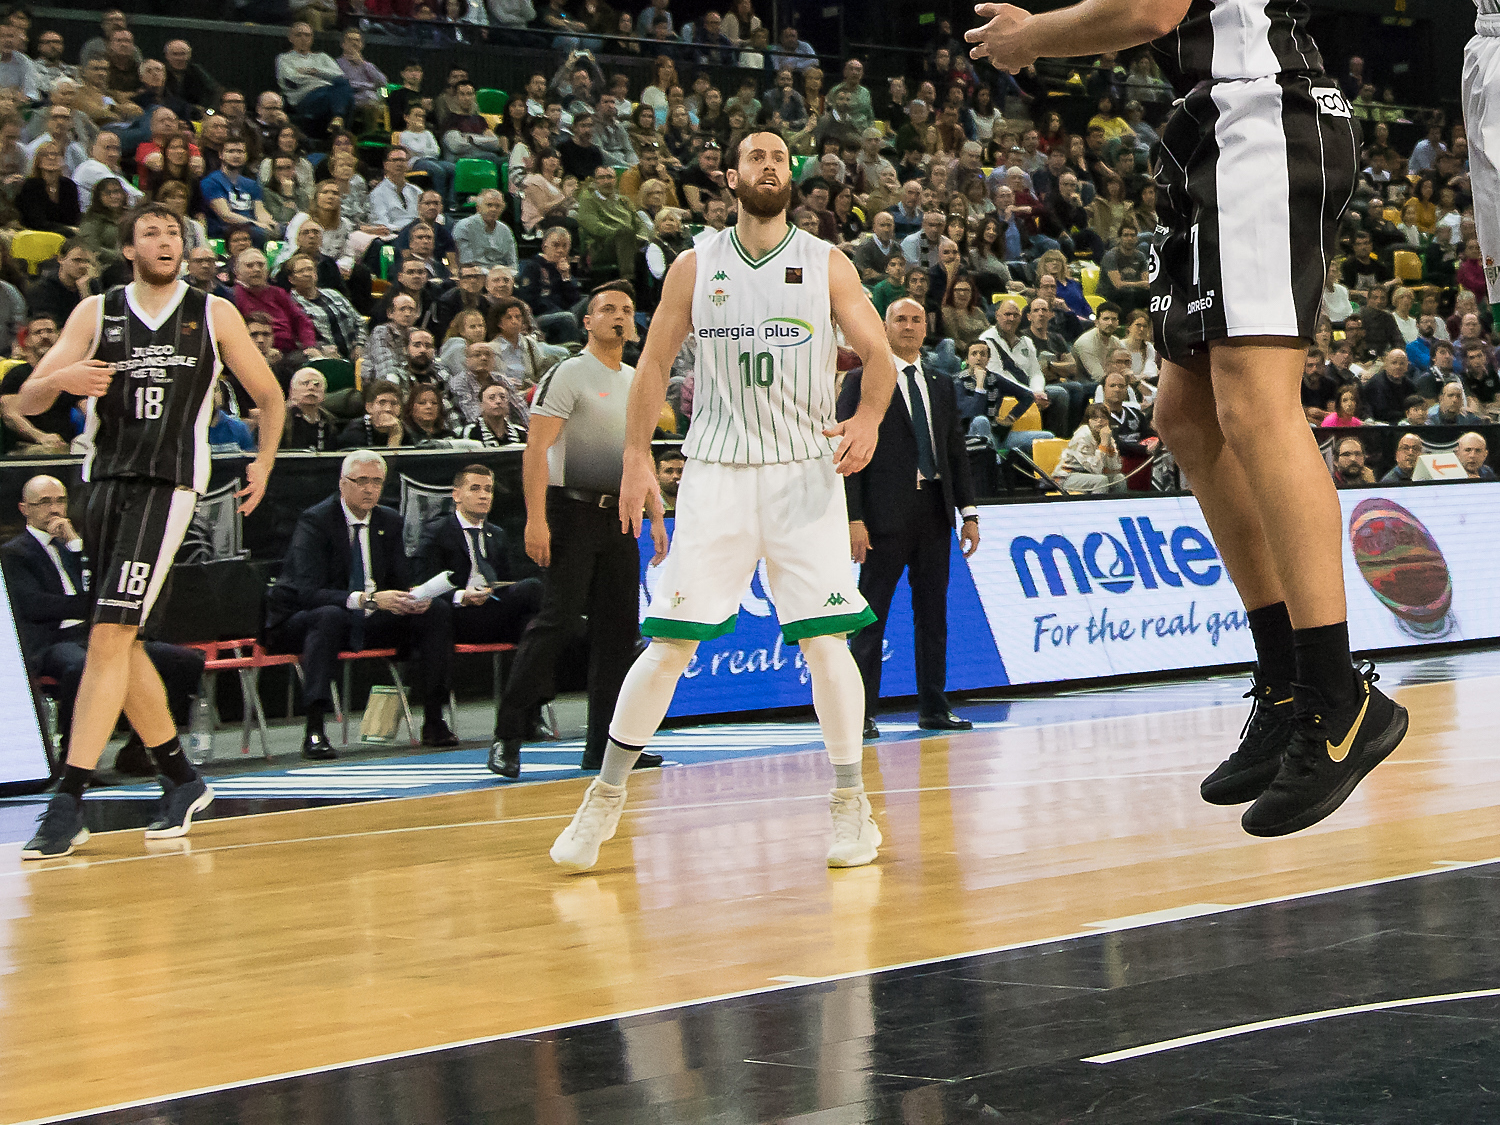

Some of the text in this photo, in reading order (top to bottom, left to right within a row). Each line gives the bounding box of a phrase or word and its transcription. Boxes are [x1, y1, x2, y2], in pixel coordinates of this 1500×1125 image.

[699, 324, 800, 341] energía plus
[738, 351, 775, 389] 10
[134, 386, 165, 420] 18
[1010, 516, 1223, 598] molte
[117, 560, 151, 595] 18
[1034, 601, 1251, 654] For the real ga
[711, 631, 789, 676] real
